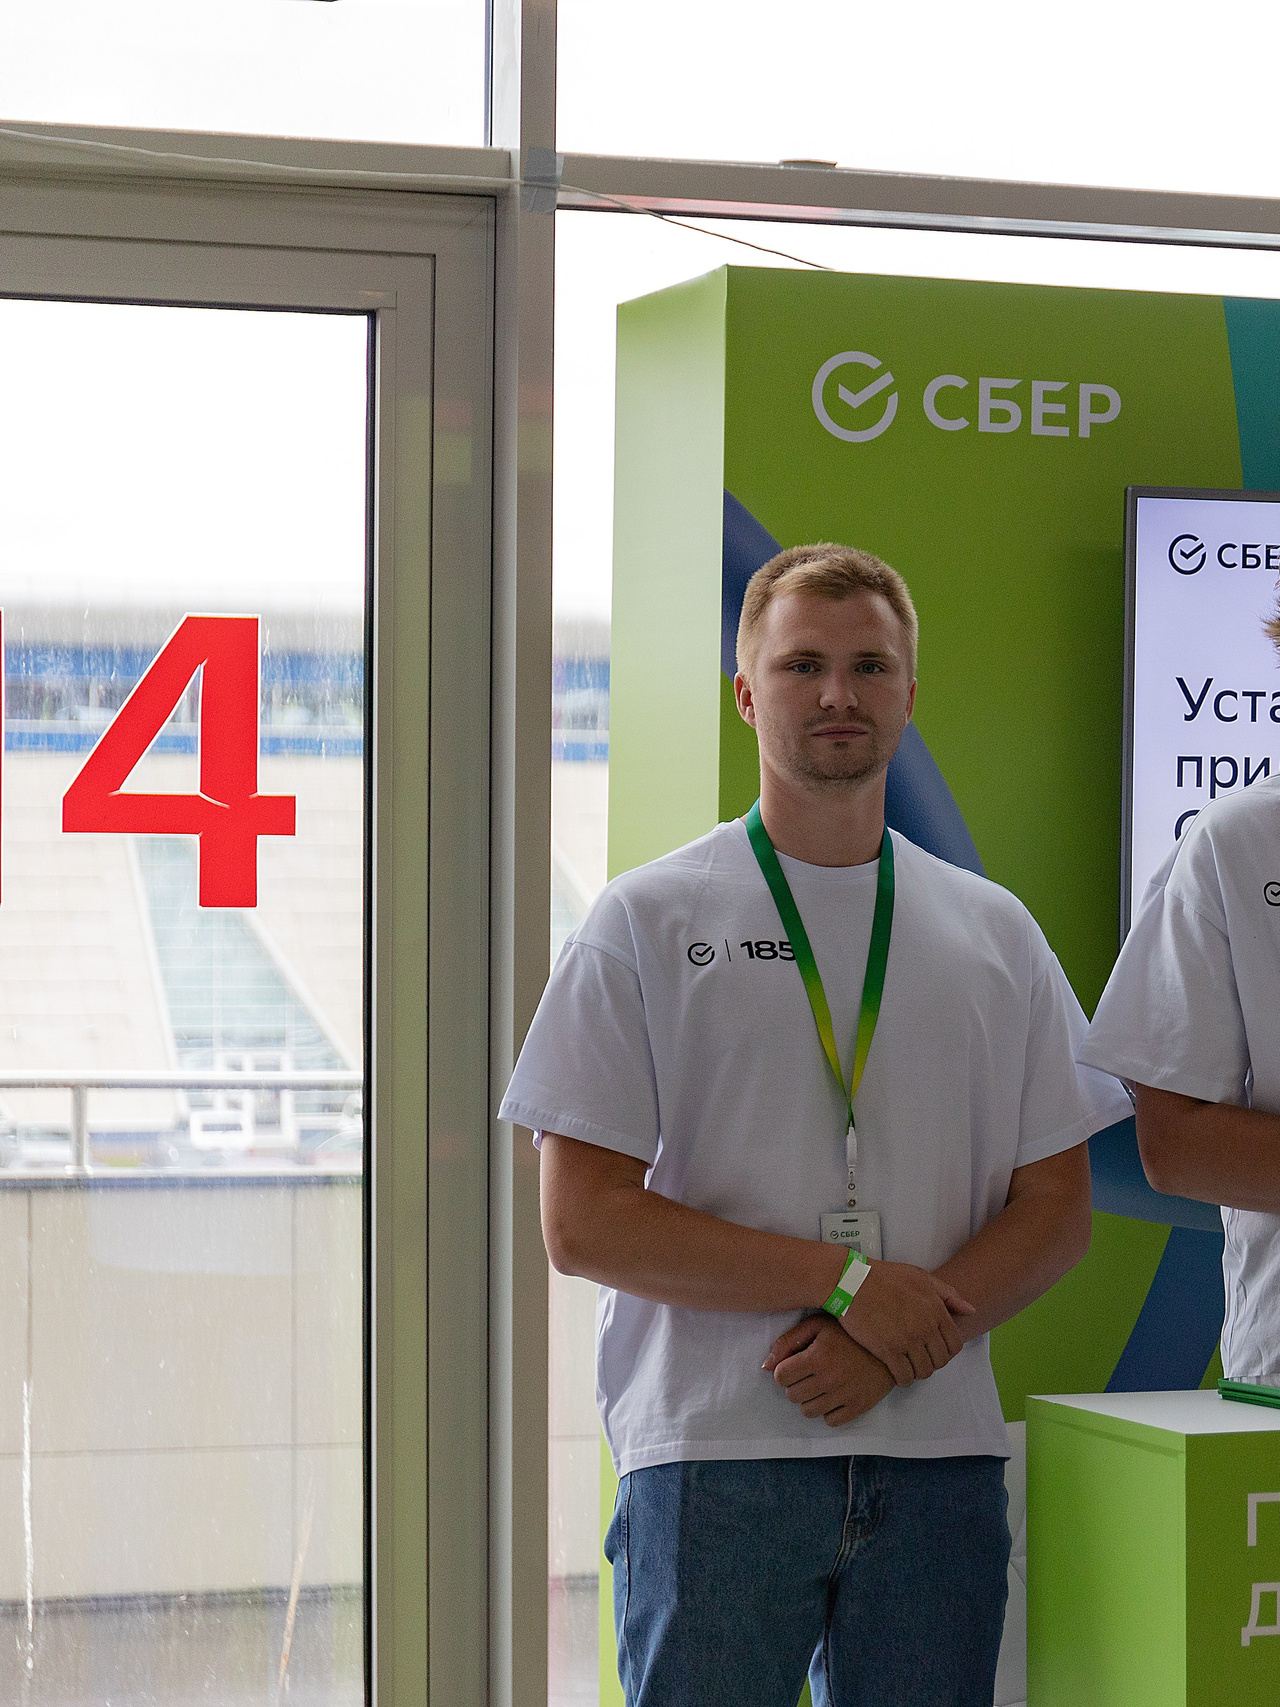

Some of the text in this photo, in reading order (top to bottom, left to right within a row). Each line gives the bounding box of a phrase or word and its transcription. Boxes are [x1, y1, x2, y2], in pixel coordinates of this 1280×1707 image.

[922, 374, 1122, 438] СБЕР
[0, 608, 296, 909] 4
[740, 940, 797, 961] 185
[840, 1230, 860, 1238] СБЕР
